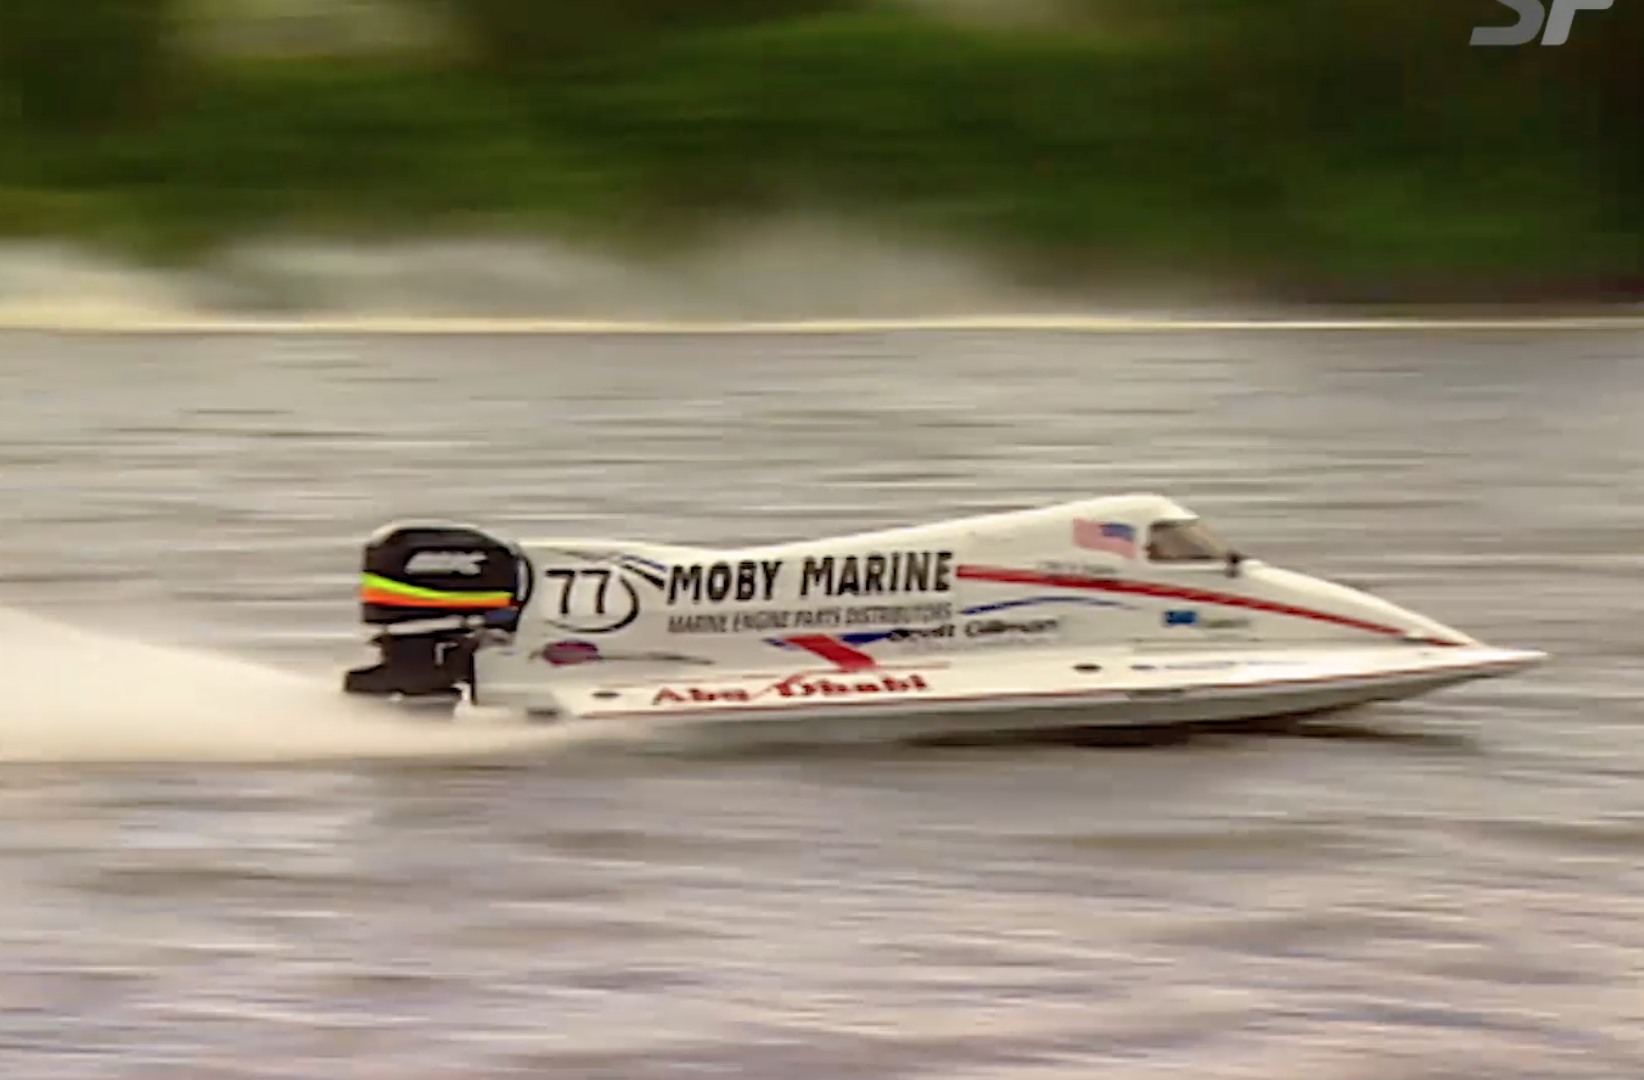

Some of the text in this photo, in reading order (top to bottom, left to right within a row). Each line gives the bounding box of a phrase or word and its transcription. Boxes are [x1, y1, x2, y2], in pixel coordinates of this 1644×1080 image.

[546, 568, 611, 615] 77
[667, 550, 953, 605] MOBY MARINE
[668, 613, 727, 633] MARINE
[732, 610, 790, 630] ENGINE
[795, 607, 841, 628] PARTS
